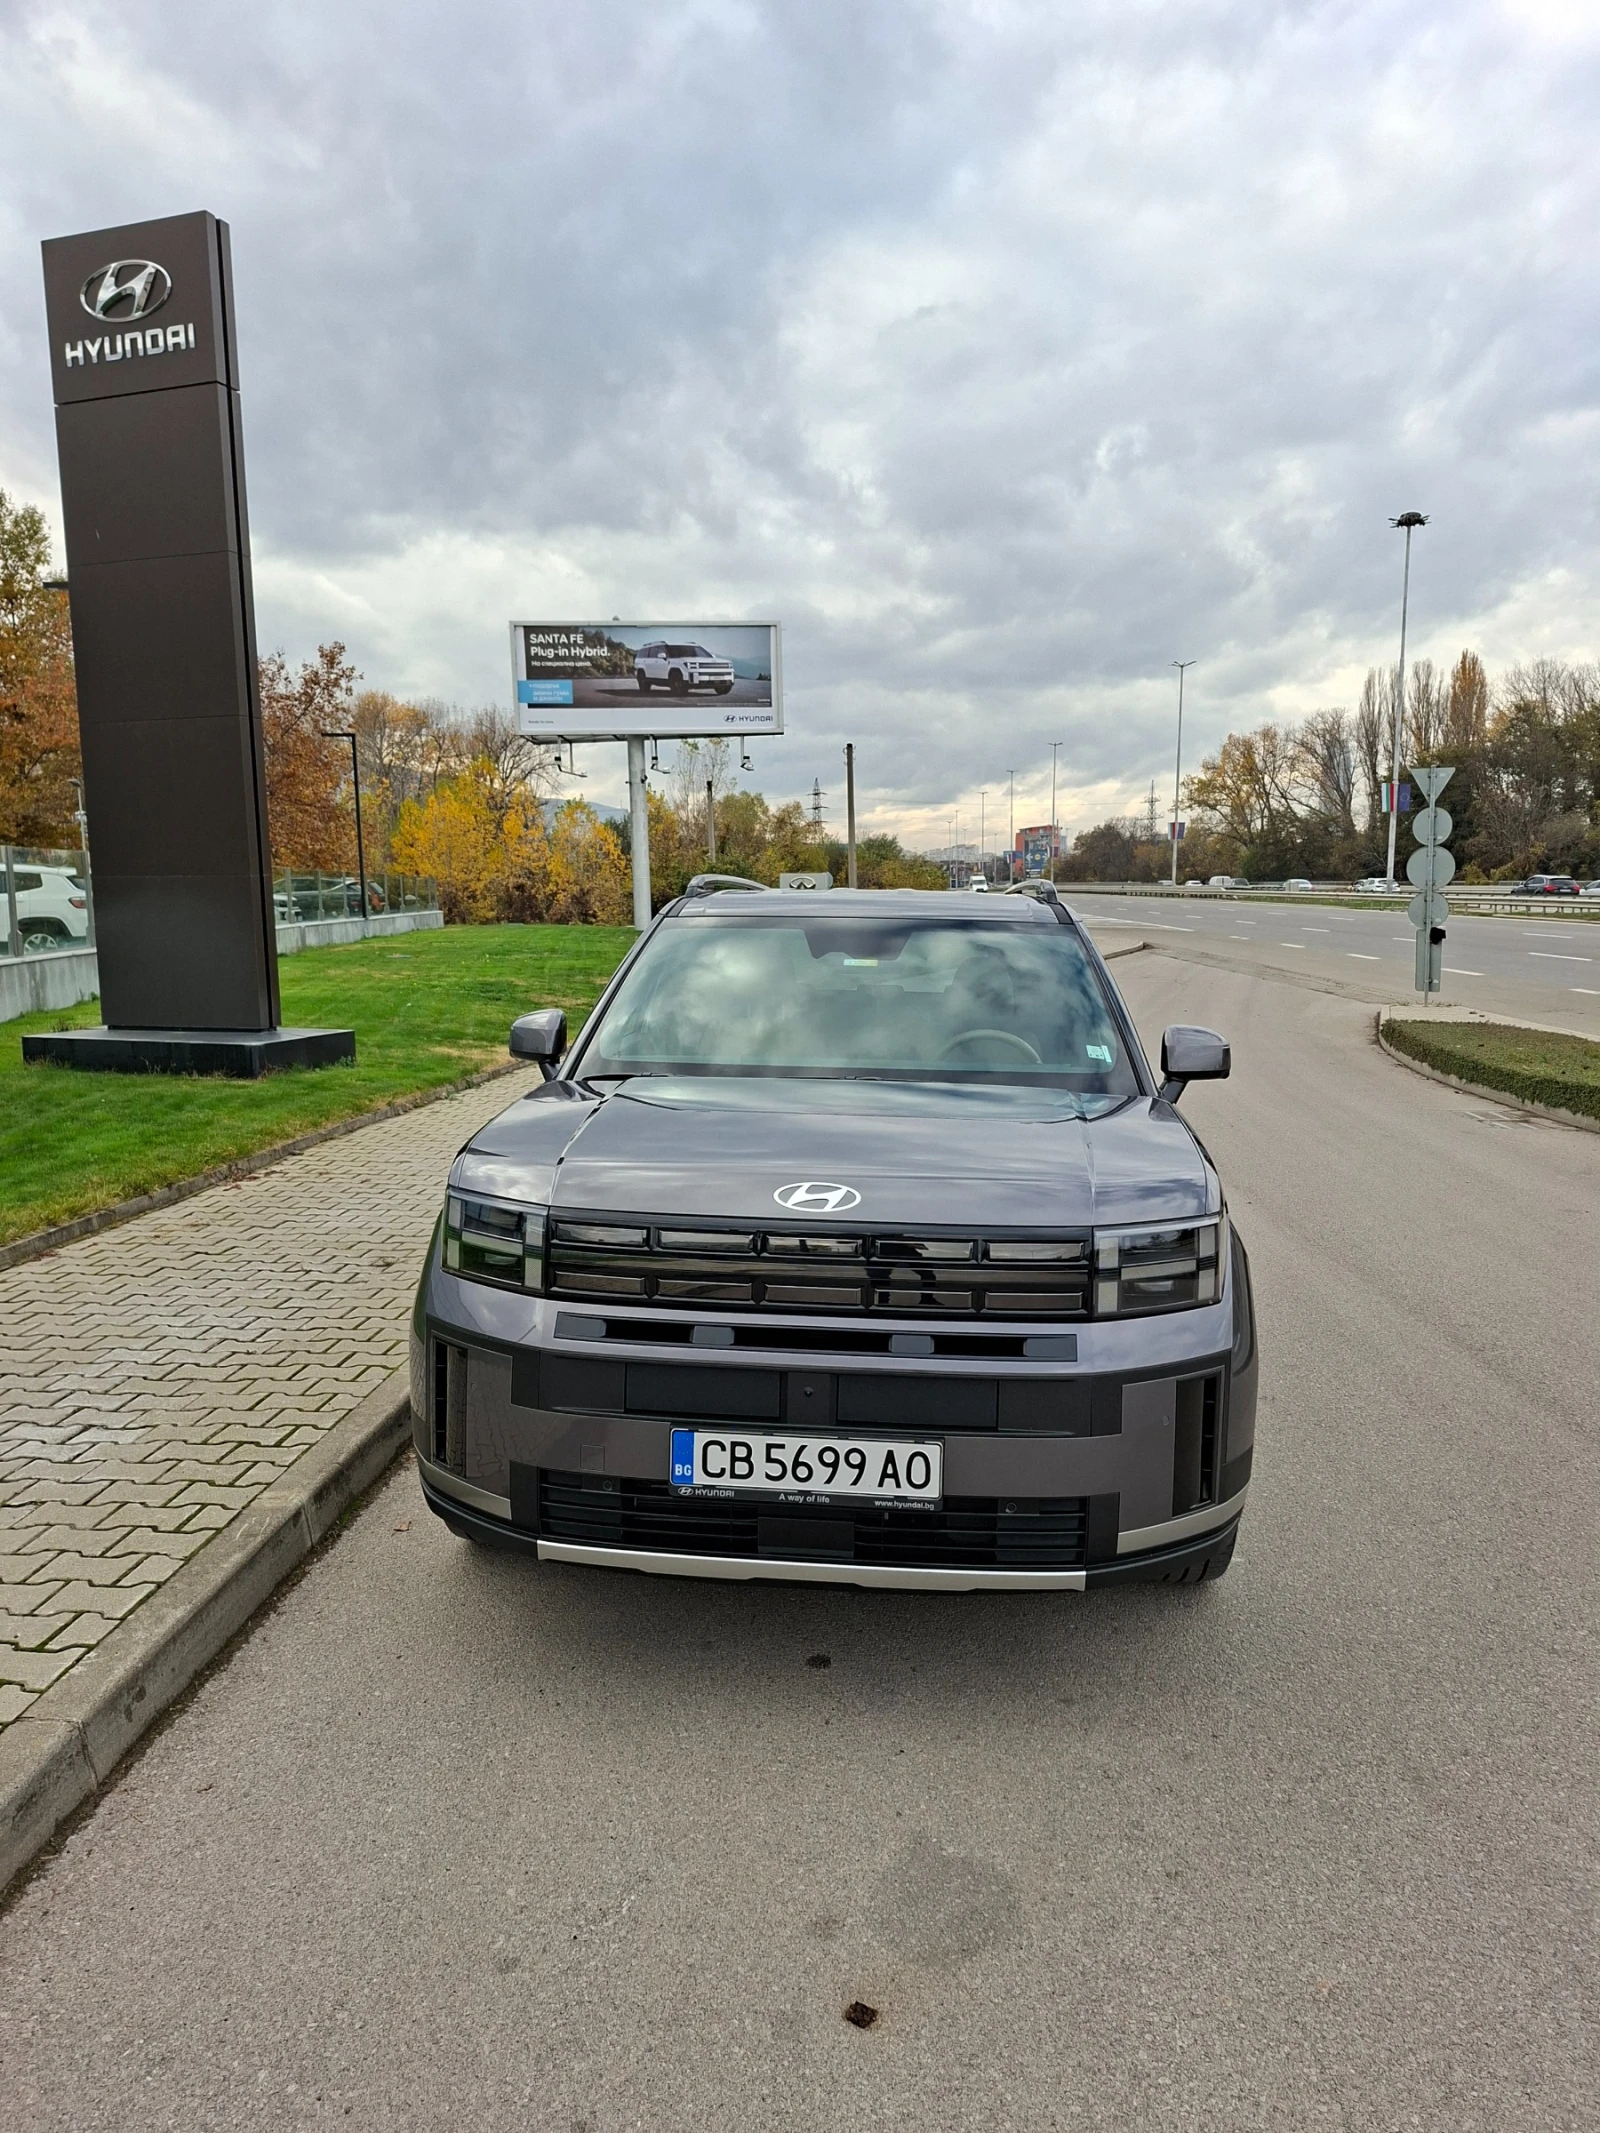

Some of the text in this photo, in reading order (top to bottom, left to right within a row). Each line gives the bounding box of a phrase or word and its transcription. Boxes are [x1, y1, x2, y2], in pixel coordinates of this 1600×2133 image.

[65, 322, 196, 368] HYUNDAI
[529, 633, 583, 644] SANTA FE
[530, 646, 611, 659] Plug-in Hybrid.
[674, 1463, 692, 1476] BG
[701, 1439, 932, 1490] CB 5699 AO
[695, 1488, 735, 1498] HYUNDAI
[778, 1492, 830, 1504] A way of life
[874, 1499, 935, 1511] www.hyundai.bg
